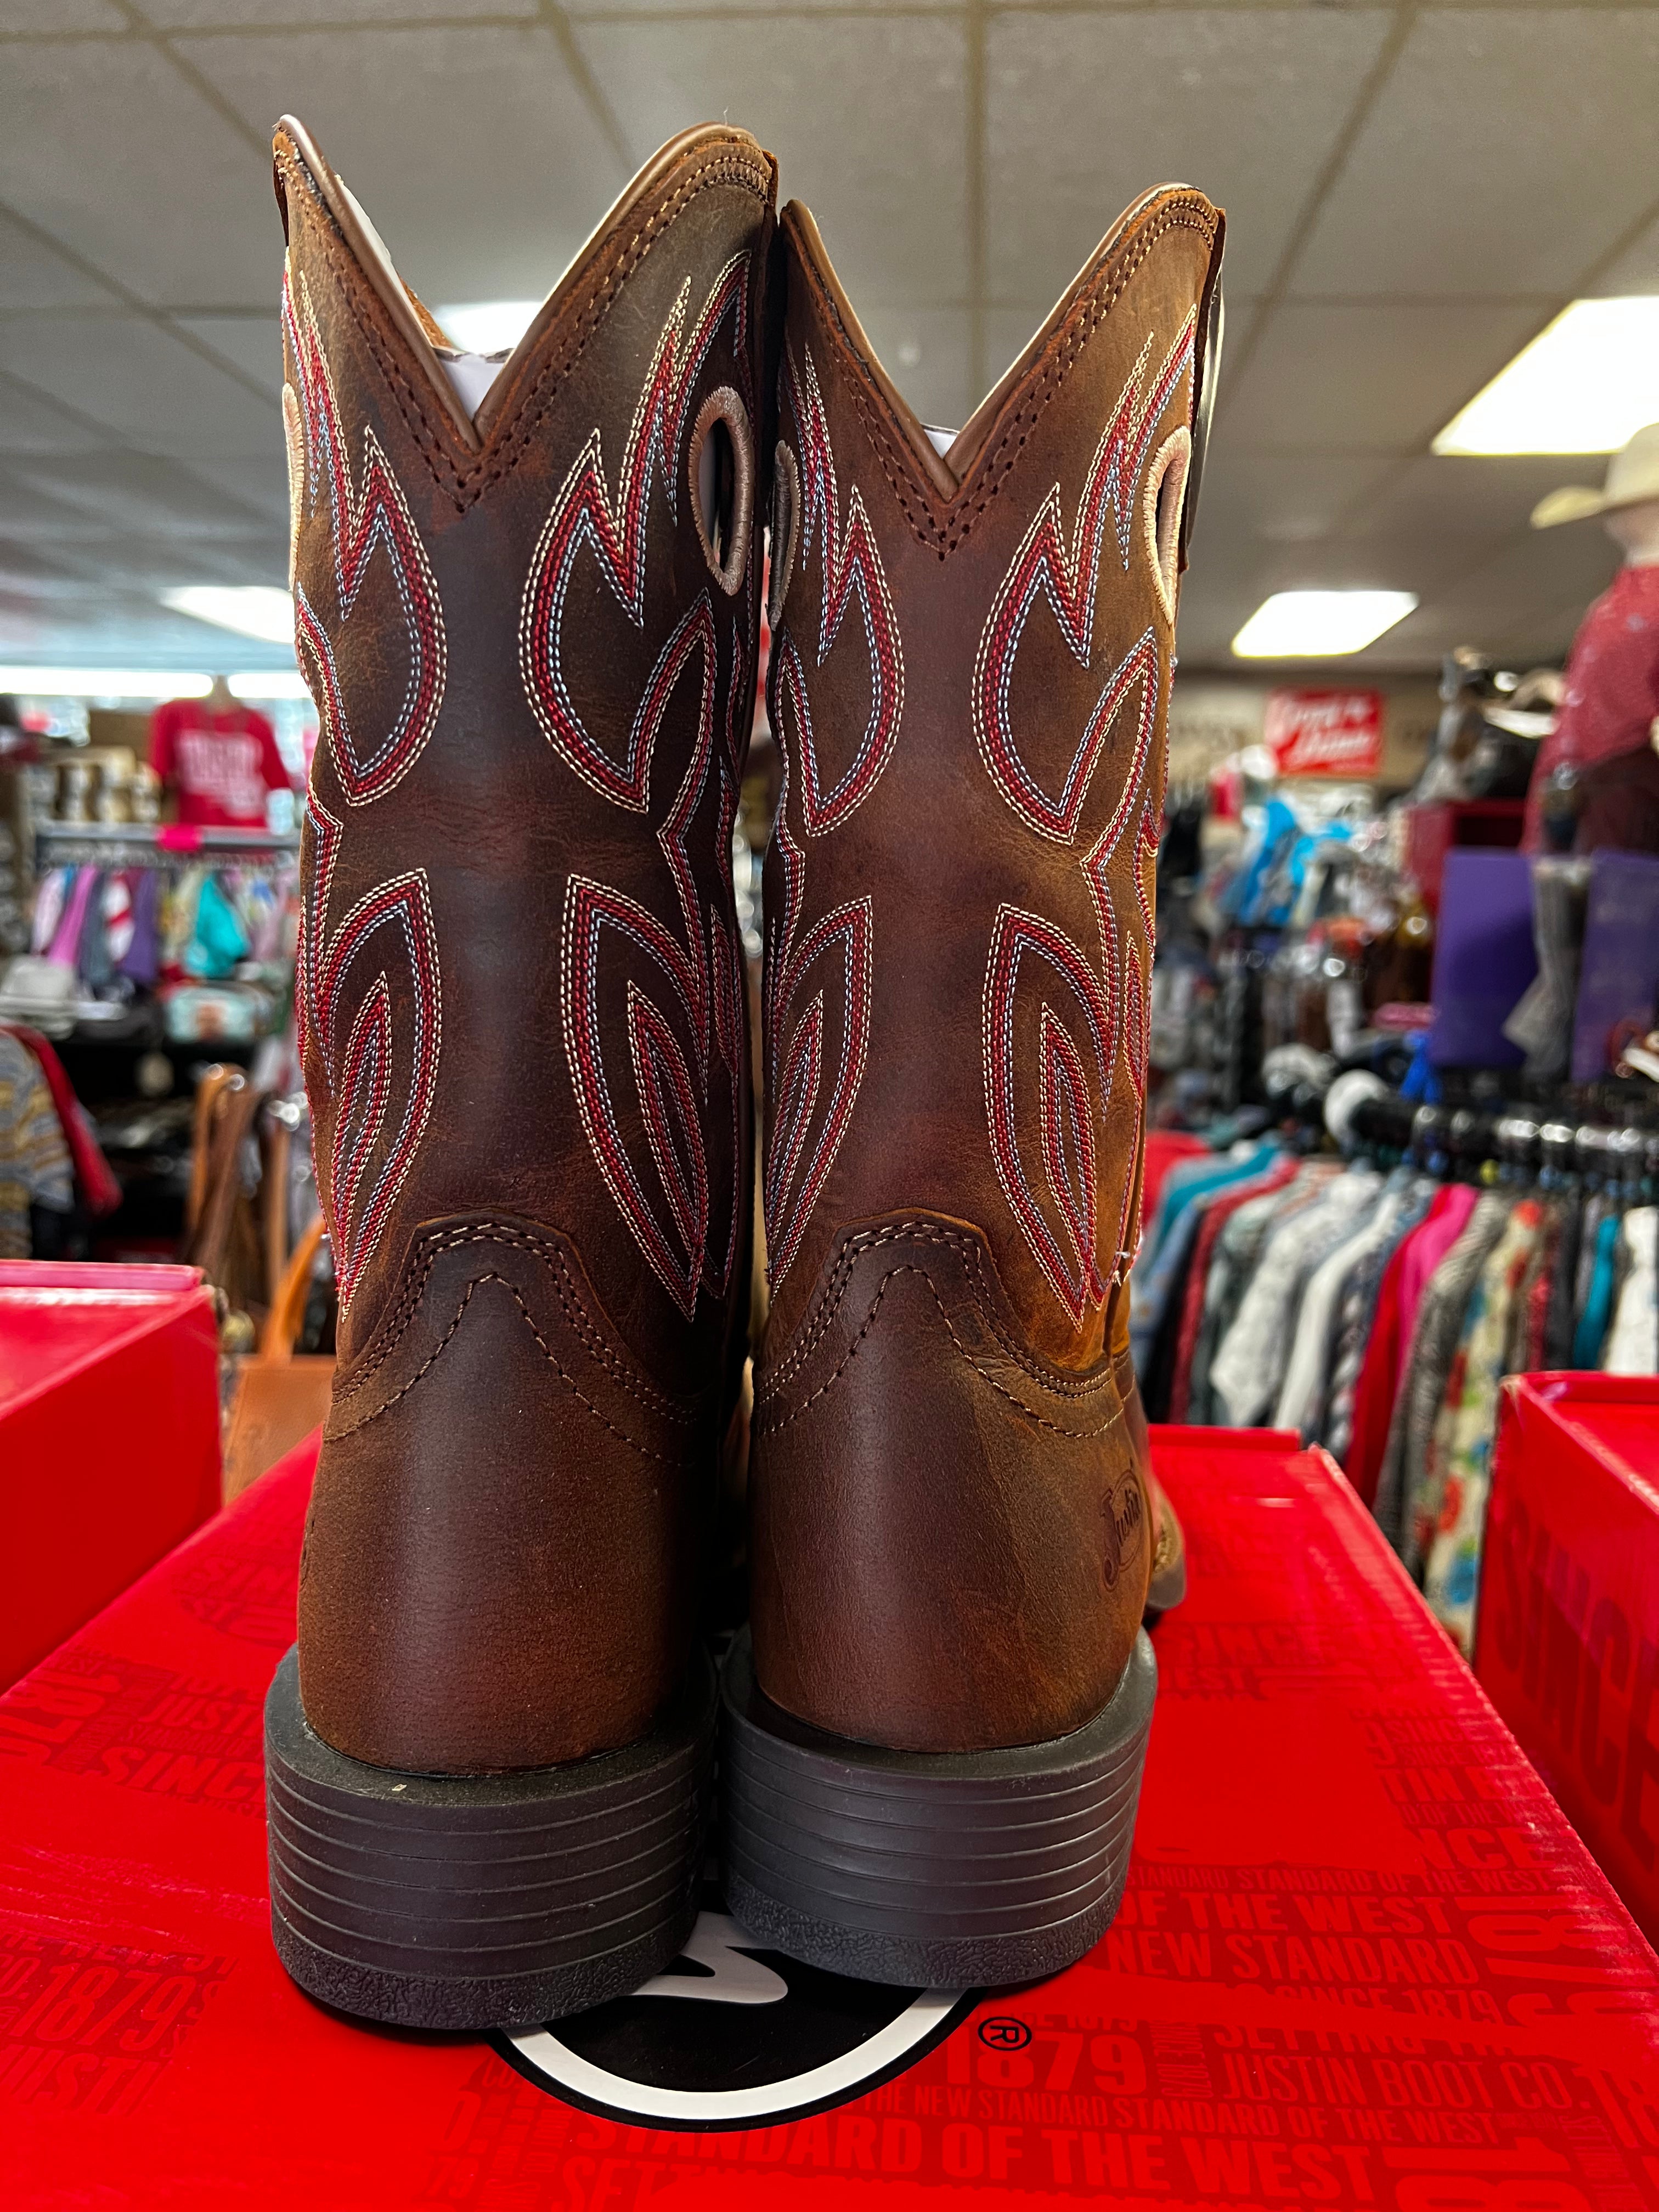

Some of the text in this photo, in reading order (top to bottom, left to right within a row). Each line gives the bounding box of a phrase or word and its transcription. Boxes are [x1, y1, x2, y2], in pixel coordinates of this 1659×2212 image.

[1236, 1867, 1373, 1892] STANDARD
[1376, 1870, 1411, 1892] OF
[1420, 1871, 1472, 1893] THE
[1472, 1870, 1549, 1892] WEST
[1180, 1892, 1289, 1931] THE
[1293, 1894, 1452, 1934] WEST
[1106, 1929, 1481, 1984] NEW STANDARD
[8, 1963, 196, 2052] 1879
[947, 2024, 1148, 2095] 1879
[1156, 2063, 1214, 2099] 1879
[1223, 2052, 1591, 2110] JUSTIN BOOT CO.
[914, 2086, 970, 2118] NEW
[979, 2090, 1108, 2128] STANDARD
[1113, 2097, 1280, 2137] STANDARD
[1286, 2106, 1329, 2139] OF
[1335, 2107, 1403, 2143] THE
[1403, 2109, 1500, 2145] WEST
[941, 2123, 1025, 2180] OF
[1041, 2129, 1171, 2191] THE
[1180, 2137, 1375, 2202] WEST
